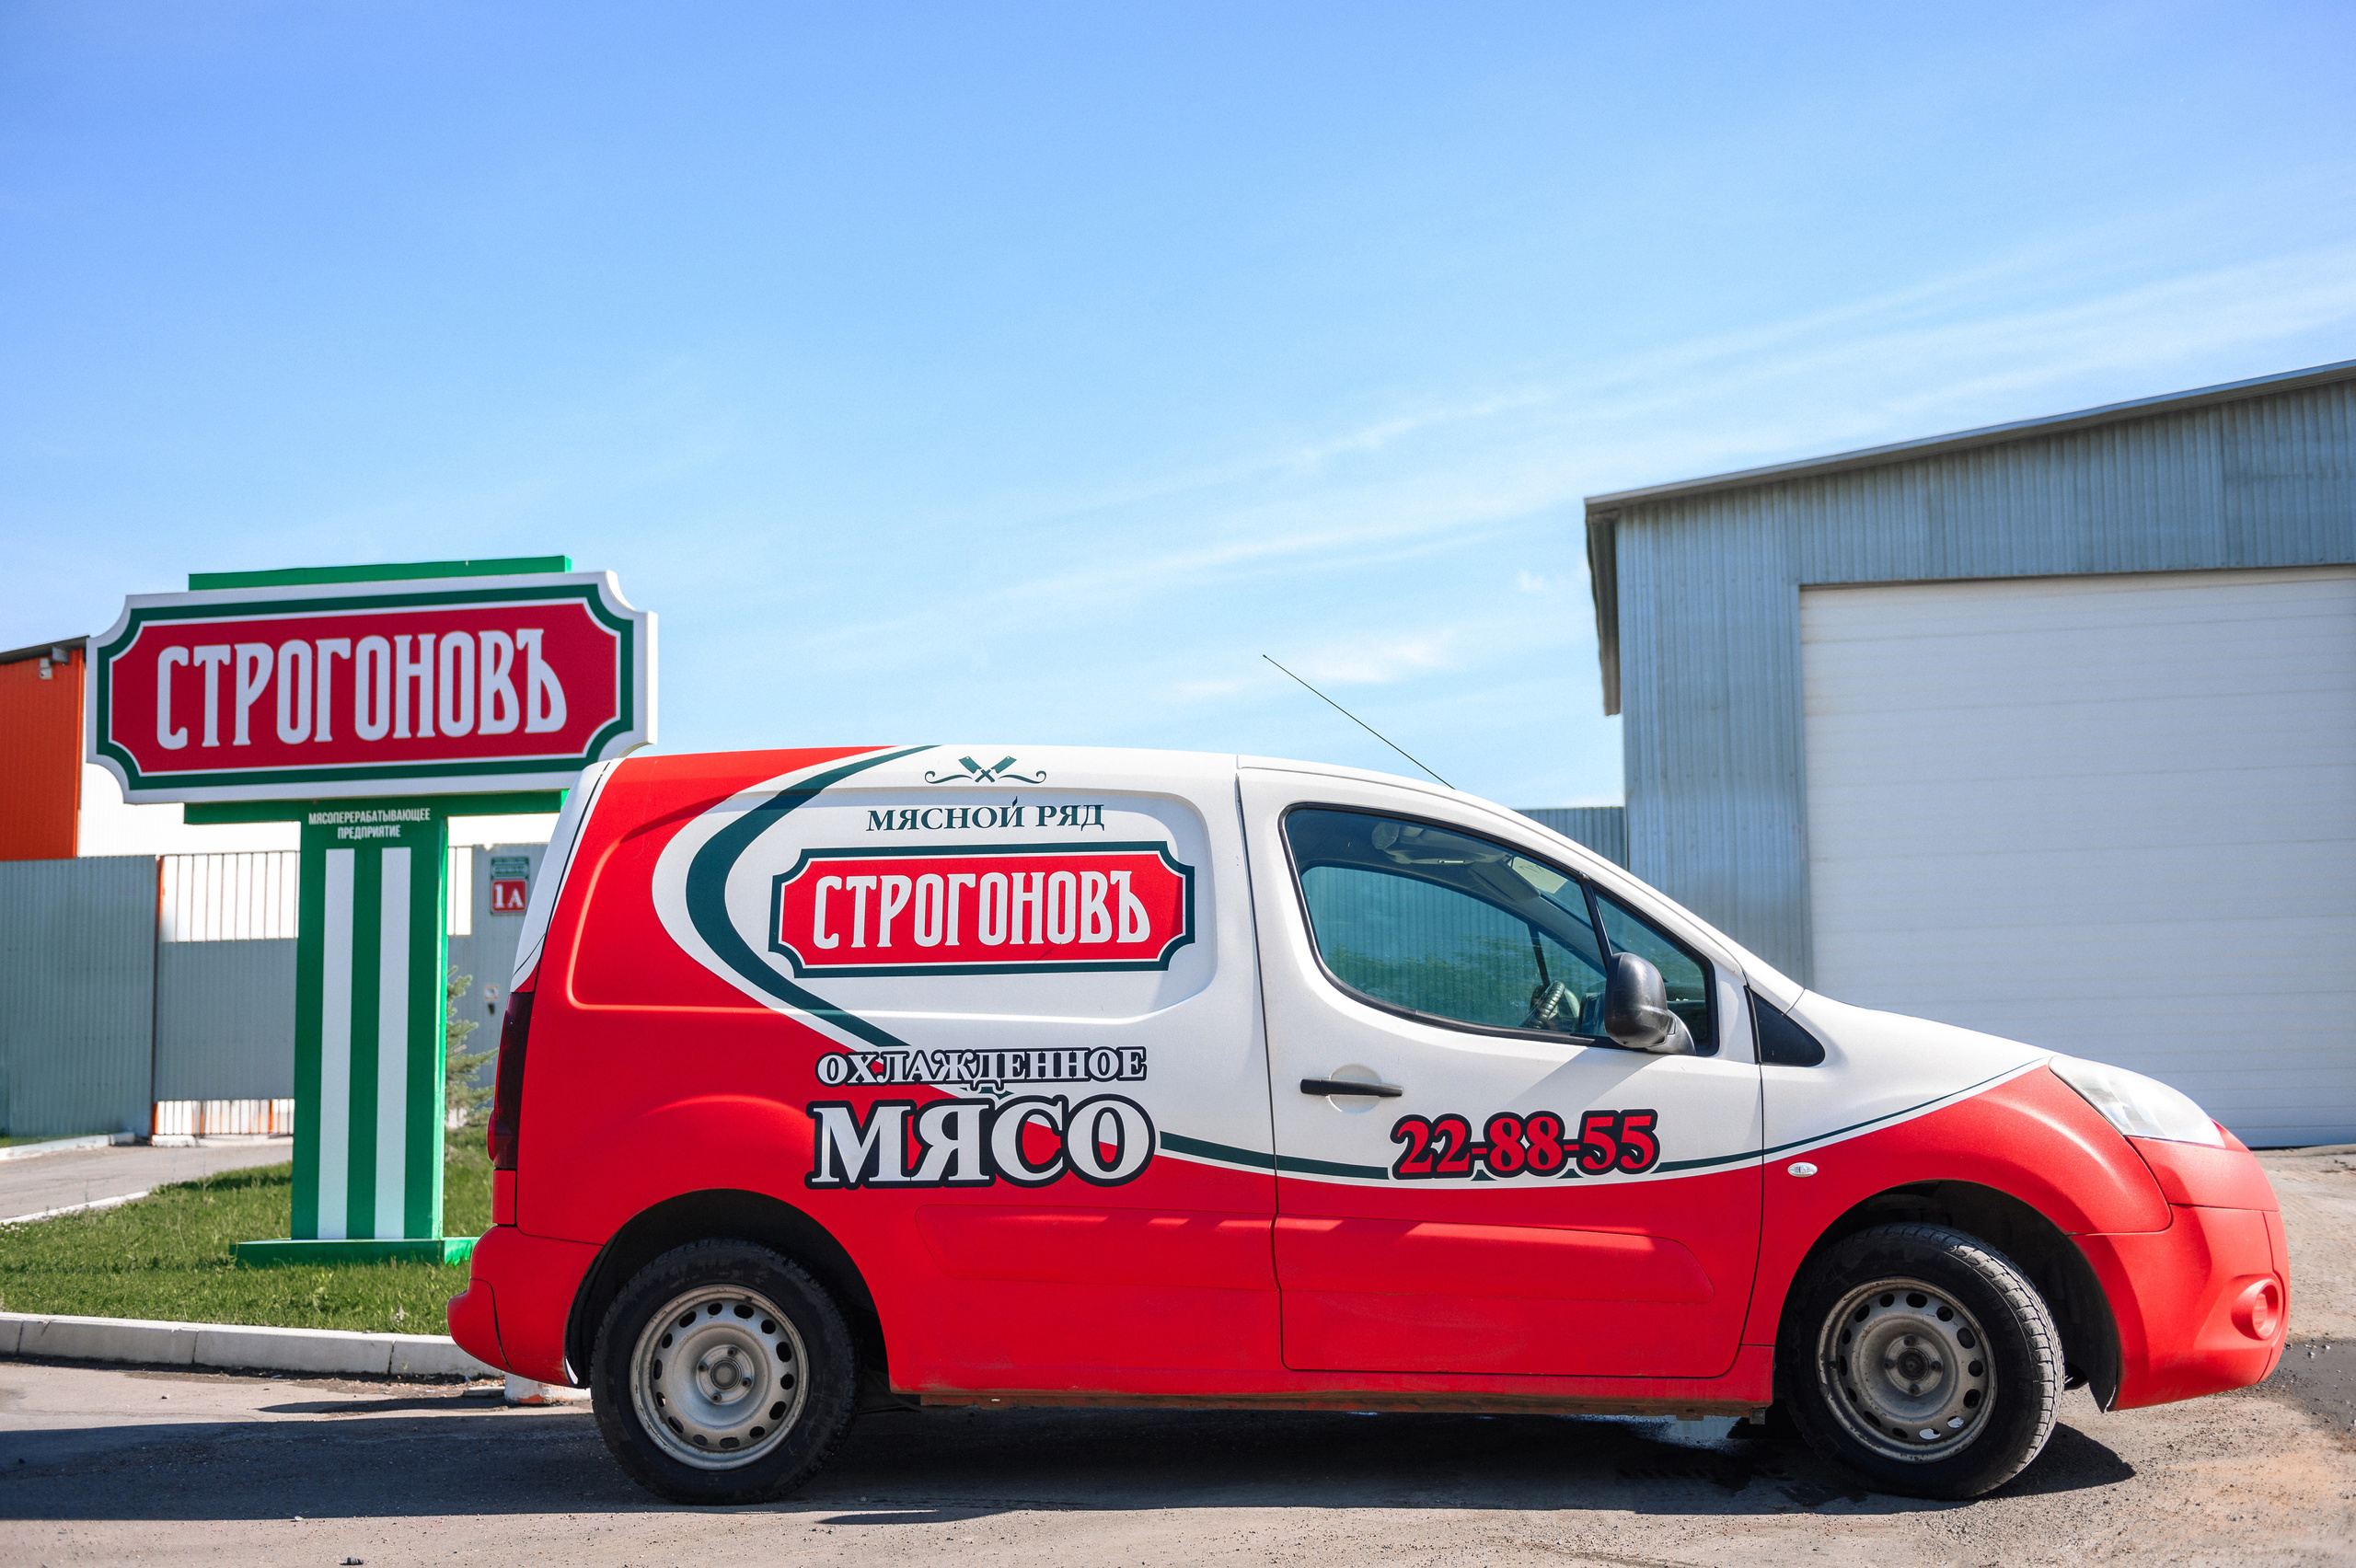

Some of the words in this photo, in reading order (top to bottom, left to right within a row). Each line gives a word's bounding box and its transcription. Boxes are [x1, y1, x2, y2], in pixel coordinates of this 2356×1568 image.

[156, 628, 568, 750] СТРОГОНОВЪ
[308, 808, 431, 825] МЯСОПЕРЕРАБАТЫВАЮЩЕЕ
[337, 824, 401, 840] ПРЕДПРИЯТИЕ
[866, 796, 1025, 831] МЯСНОЙ
[1035, 803, 1104, 832] РЯД
[813, 870, 1150, 949] СТРОГОНОВЪ
[815, 1046, 1148, 1091] ОХЛАЖДЕННОЕ
[805, 1093, 1155, 1190] МЯСО
[1390, 1109, 1660, 1180] 22-88-55
